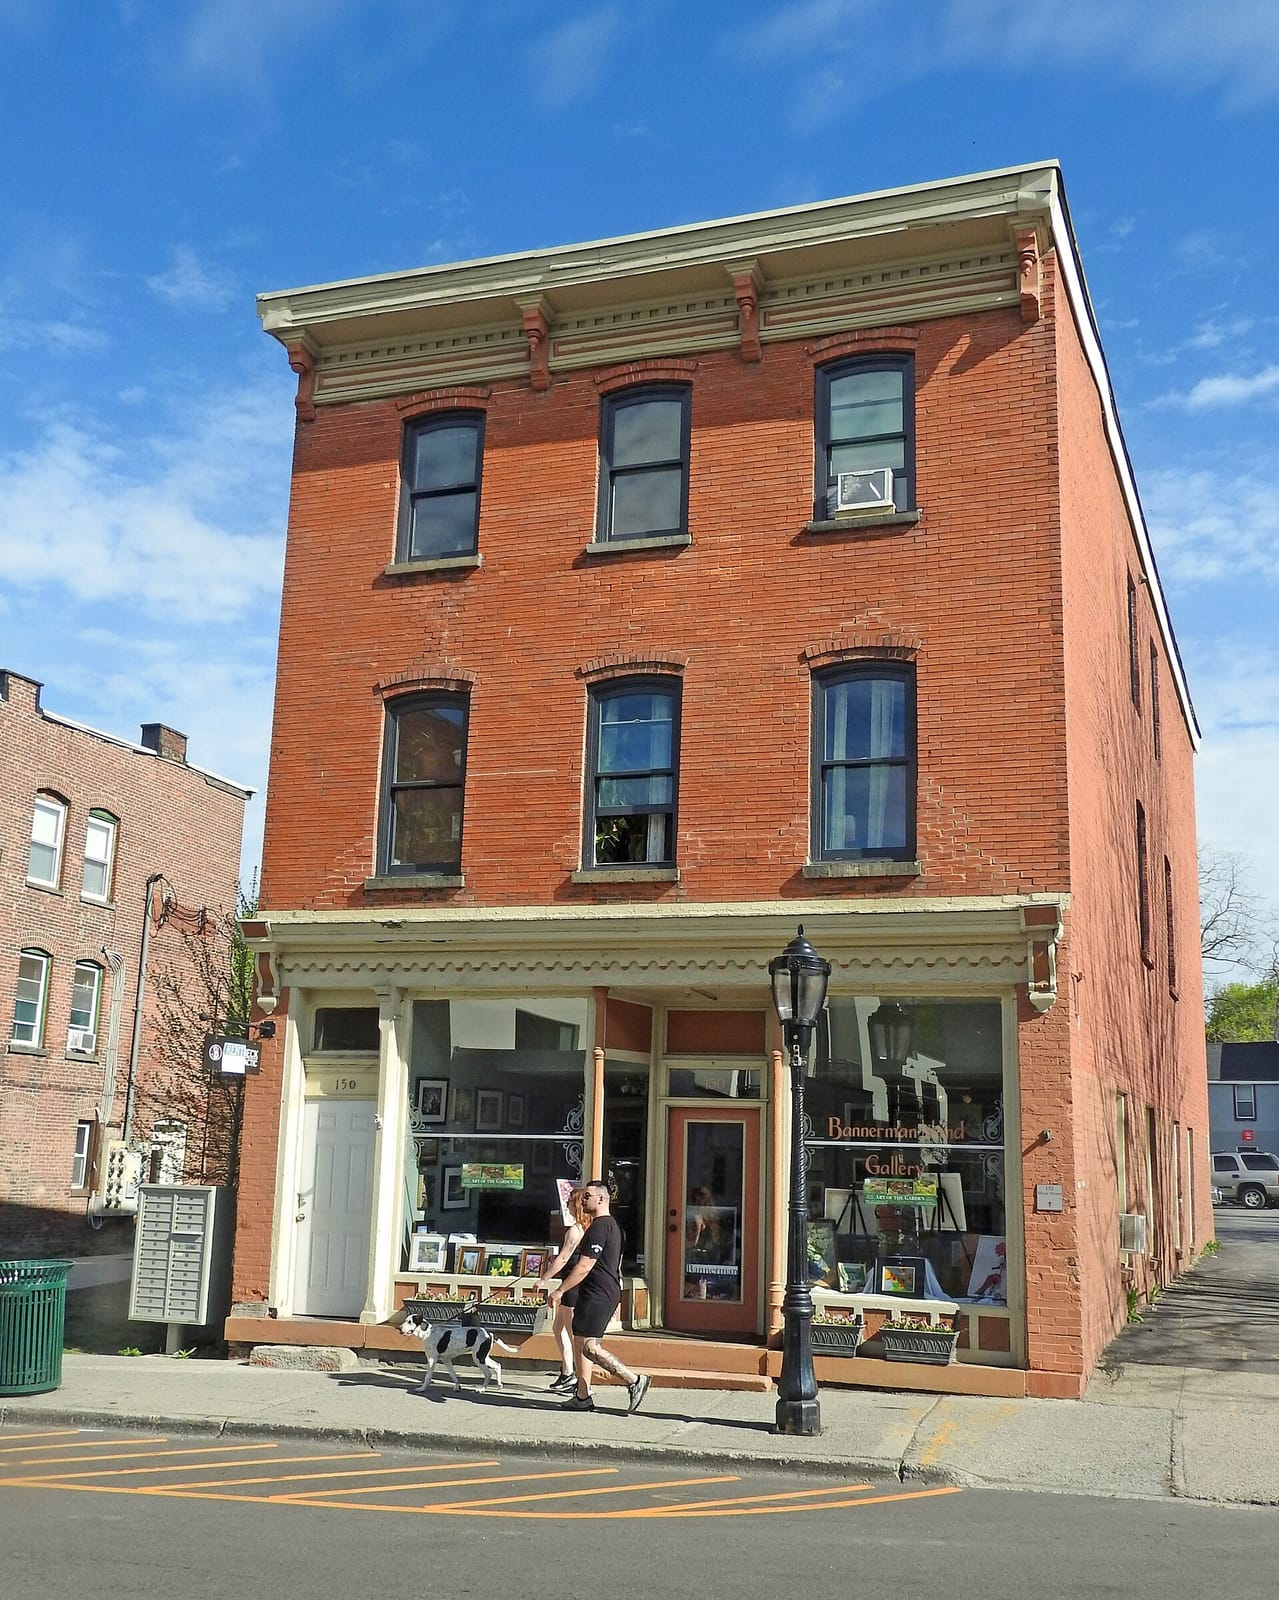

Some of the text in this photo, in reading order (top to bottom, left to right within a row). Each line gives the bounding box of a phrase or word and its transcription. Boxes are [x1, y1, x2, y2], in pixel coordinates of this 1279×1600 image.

[336, 1079, 356, 1090] 150
[828, 1116, 917, 1139] Bannerman
[864, 1153, 926, 1179] Gallery
